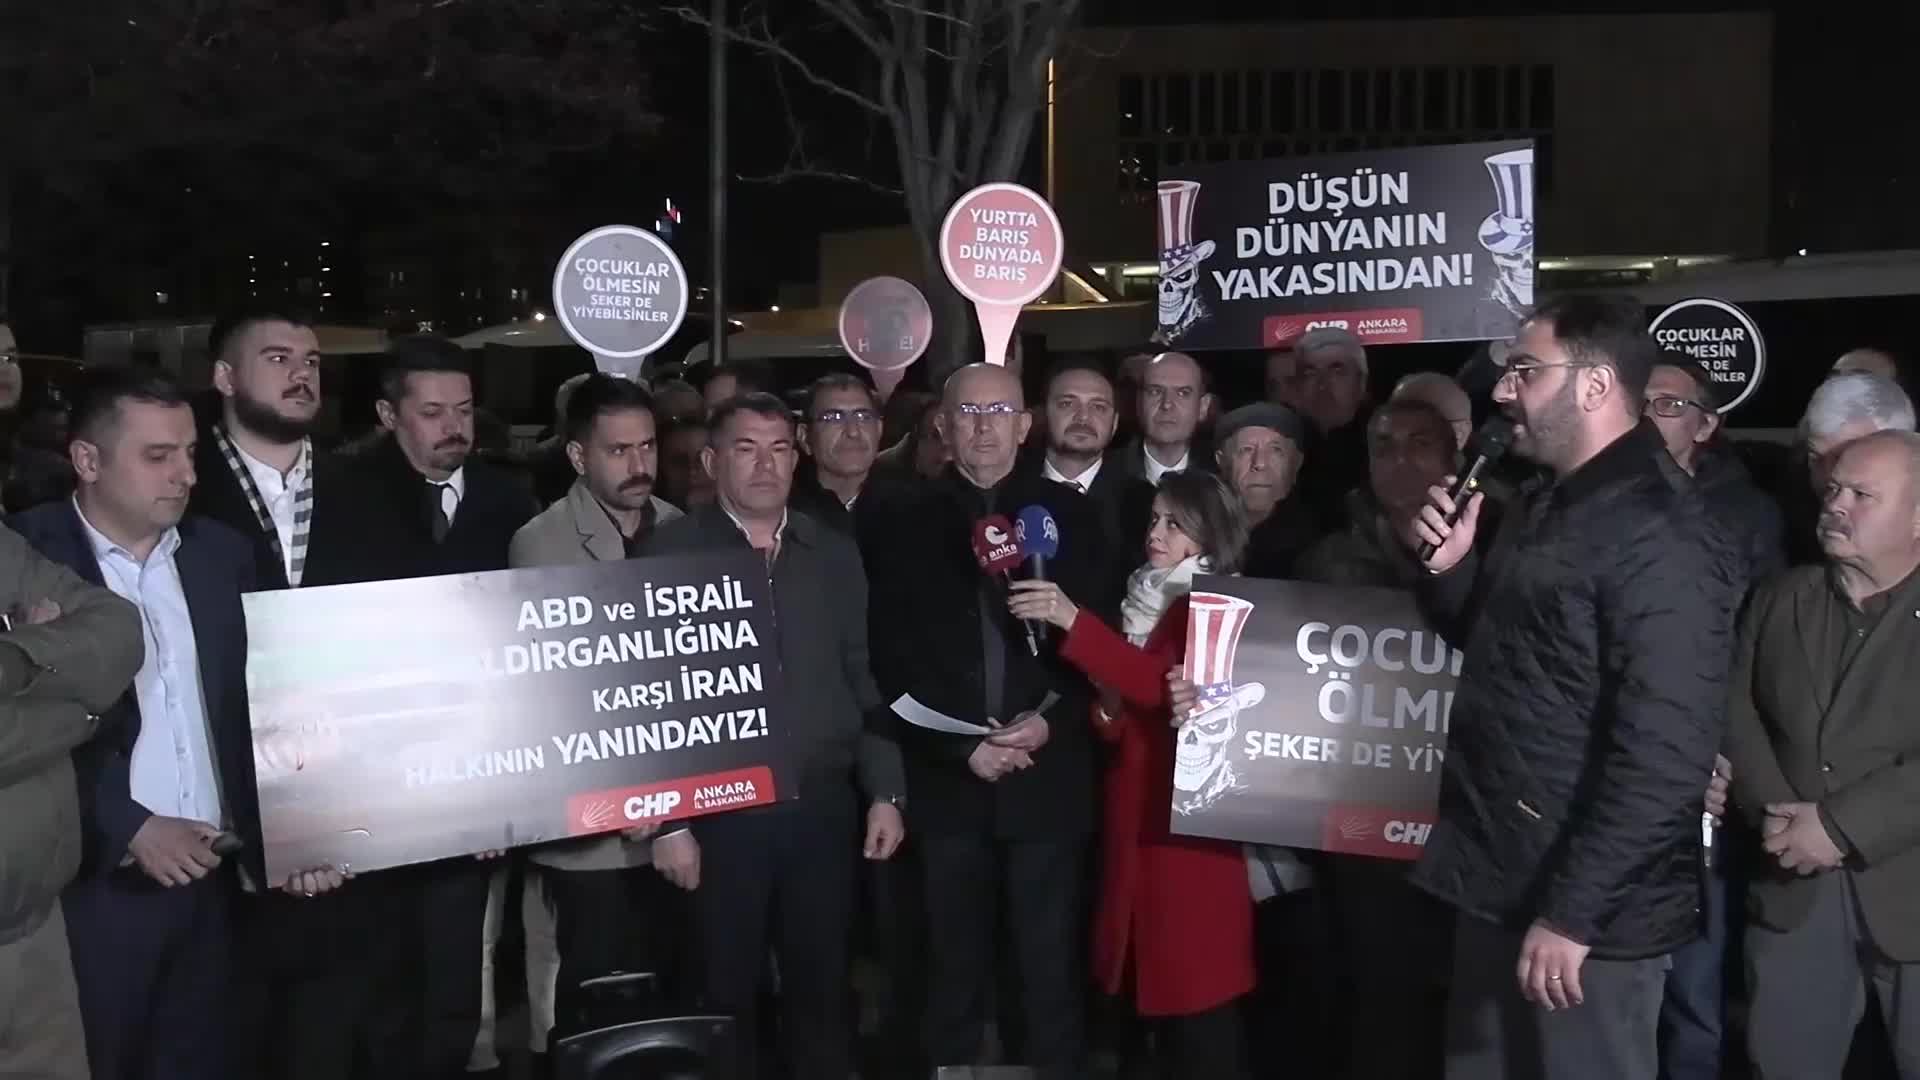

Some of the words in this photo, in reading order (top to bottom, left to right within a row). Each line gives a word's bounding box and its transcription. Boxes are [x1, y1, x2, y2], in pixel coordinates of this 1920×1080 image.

[1269, 168, 1409, 217] DÜŞÜN
[970, 208, 1038, 228] YURTTA
[976, 228, 1029, 247] BARIŞ
[1236, 212, 1447, 259] DÜNYANIN
[959, 243, 1044, 265] DÜNYADA
[575, 258, 670, 278] ÇOCUKLAR
[974, 264, 1027, 284] BARIŞ
[1212, 254, 1473, 301] YAKASINDAN!
[583, 274, 660, 295] ÖLMESİN
[635, 297, 653, 308] DE
[572, 304, 669, 322] YİYEBİLSİNLER
[1357, 318, 1408, 330] ANKARA
[1656, 328, 1745, 346] ÇOCUKLAR
[1664, 342, 1737, 358] MESİN
[1713, 360, 1730, 371] DE
[989, 543, 1018, 558] anka
[517, 596, 593, 631] ABD
[603, 602, 636, 623] ve
[644, 575, 753, 618] İSRAİL
[592, 680, 674, 712] KARŞI
[680, 663, 764, 701] İRAN
[552, 707, 769, 765] YANINDAYIZ!
[1243, 730, 1341, 762] ŞEKER
[1351, 742, 1392, 768] DE
[624, 790, 681, 820] CHP
[694, 780, 756, 800] ANKARA
[1384, 820, 1432, 845] CH
